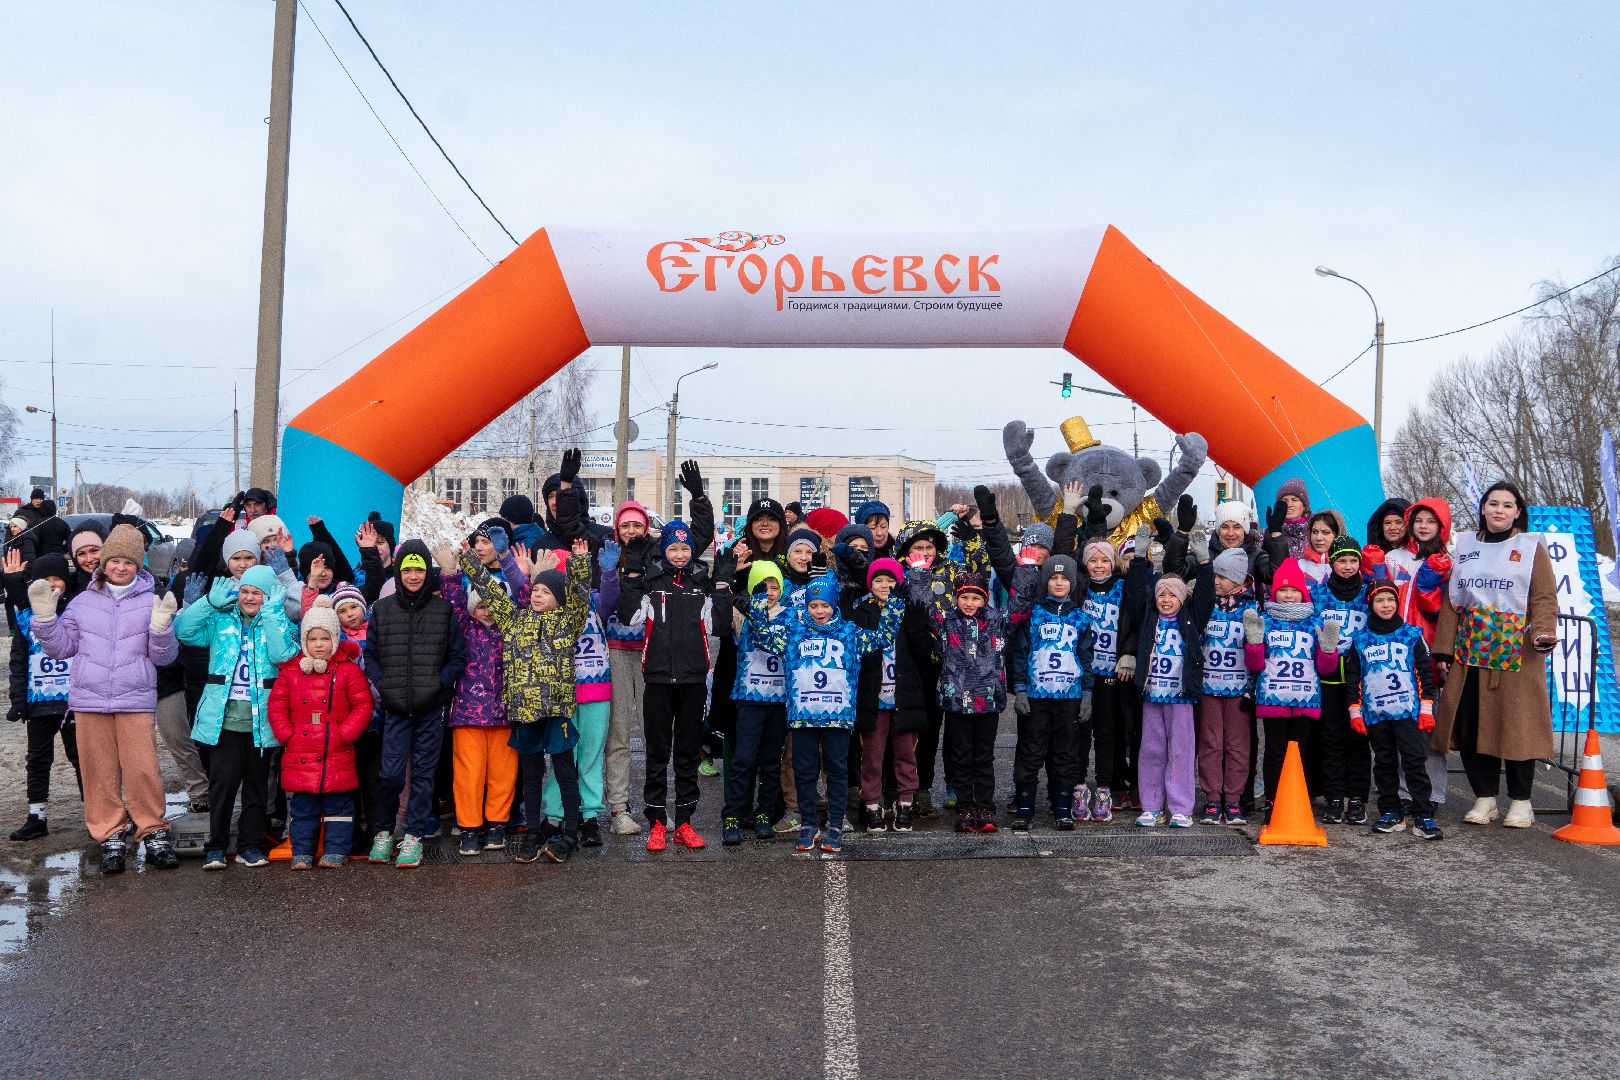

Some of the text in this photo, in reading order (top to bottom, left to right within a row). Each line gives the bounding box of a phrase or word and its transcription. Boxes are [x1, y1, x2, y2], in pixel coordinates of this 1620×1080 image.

[646, 240, 1001, 311] Егорьевск
[788, 300, 1003, 311] Гордимся традициями. Строим будущее
[803, 637, 845, 669] bella R
[1270, 630, 1314, 660] bella R
[40, 656, 69, 674] 65
[766, 655, 779, 673] 6
[1048, 652, 1062, 670] 5
[1151, 656, 1173, 675] 29
[1209, 650, 1237, 668] 95
[1367, 641, 1410, 671] bella R
[1276, 660, 1305, 679] 28
[813, 670, 828, 689] 9
[1386, 672, 1402, 690] 3
